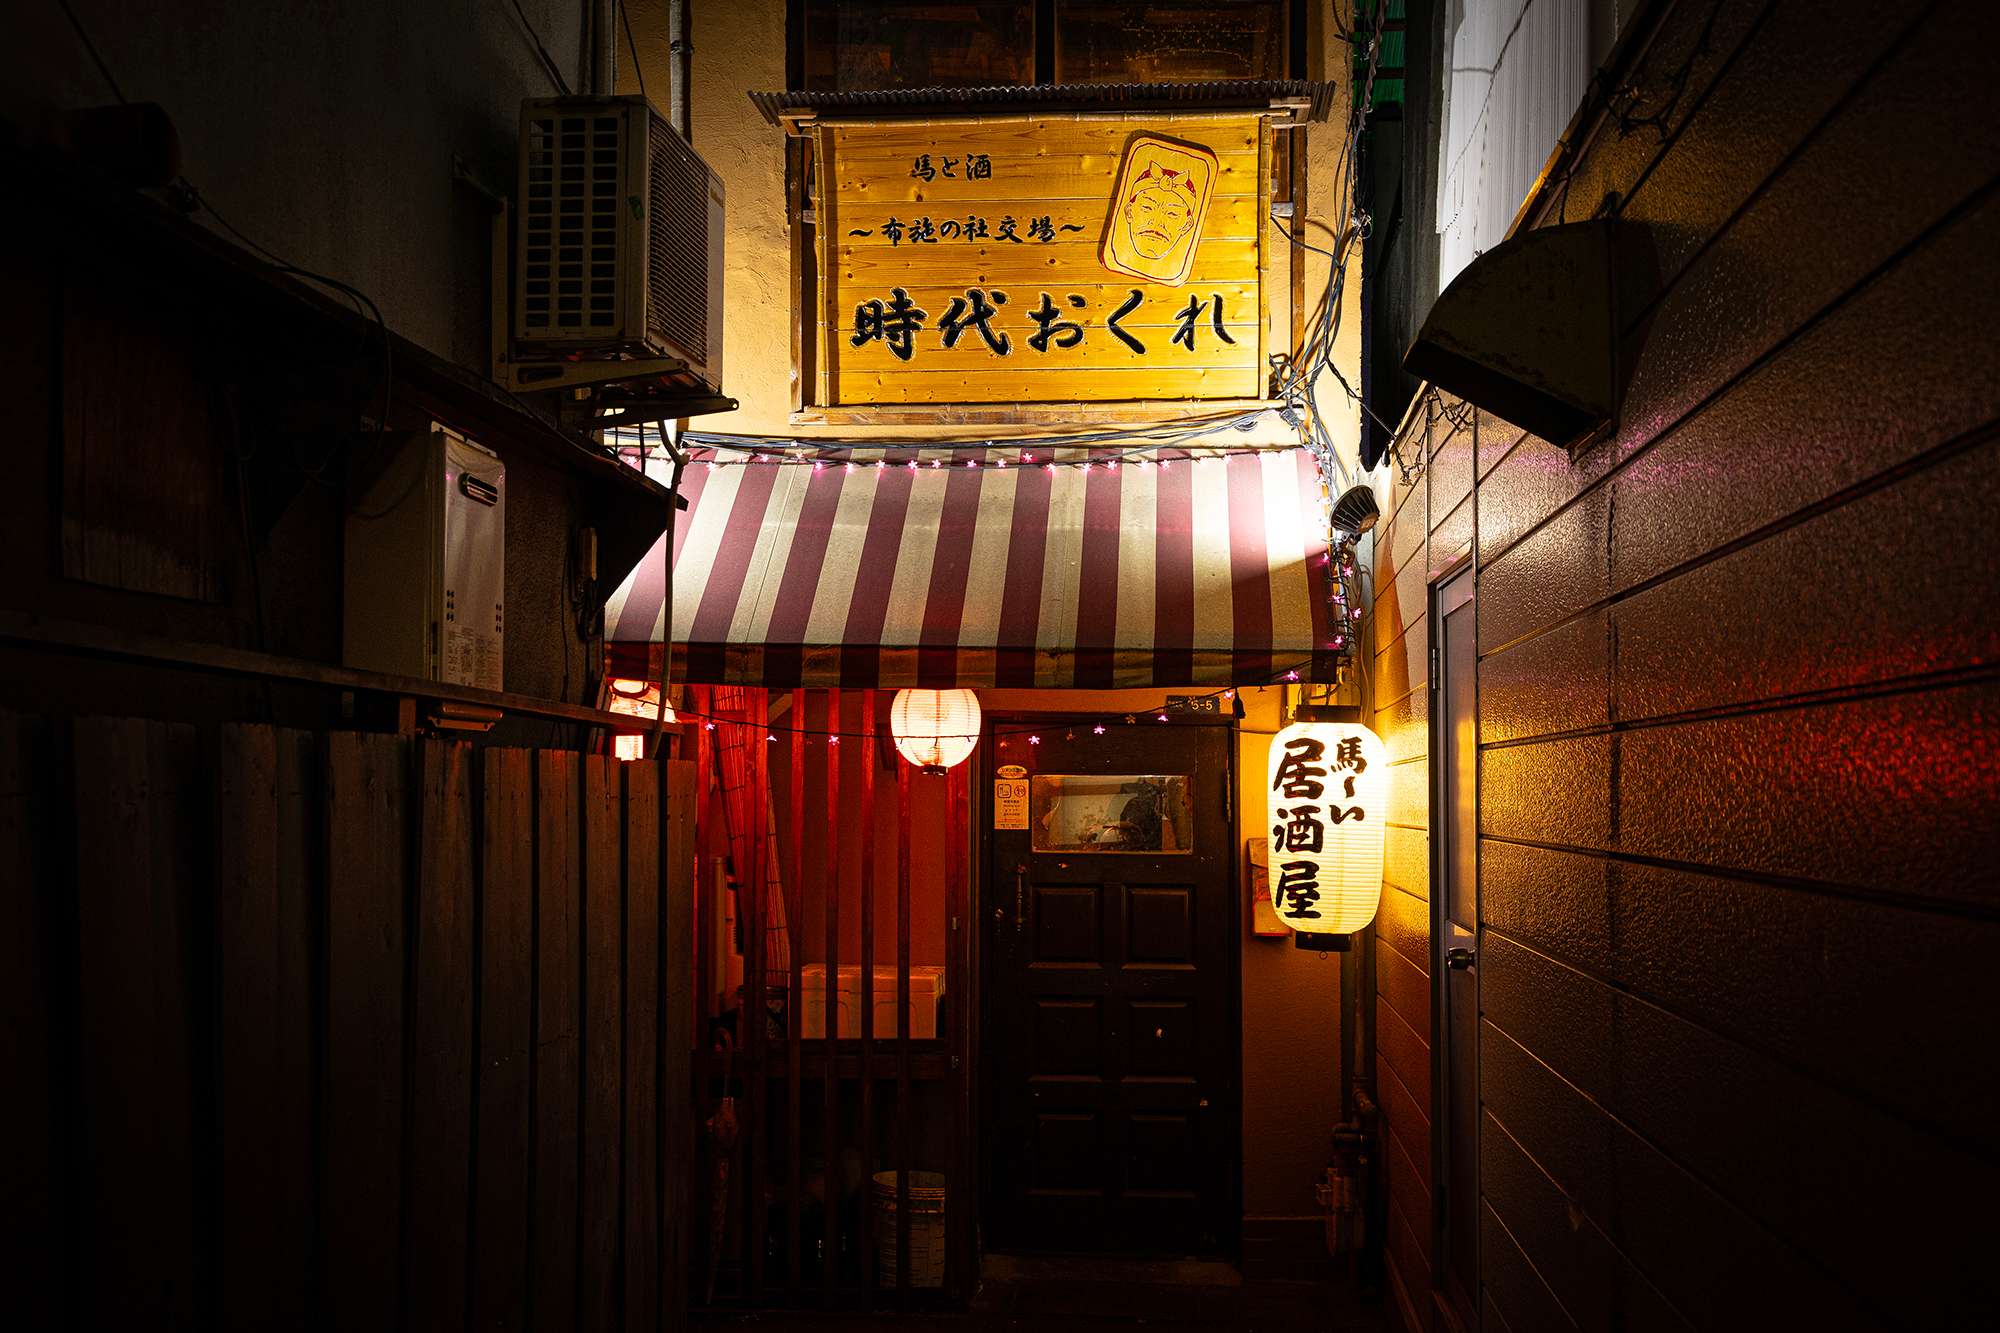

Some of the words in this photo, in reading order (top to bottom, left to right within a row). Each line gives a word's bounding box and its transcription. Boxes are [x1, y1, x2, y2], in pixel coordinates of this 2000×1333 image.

[910, 153, 992, 182] 馬と酒
[850, 287, 1236, 361] 時代おくれ
[1273, 737, 1327, 919] 居酒屋
